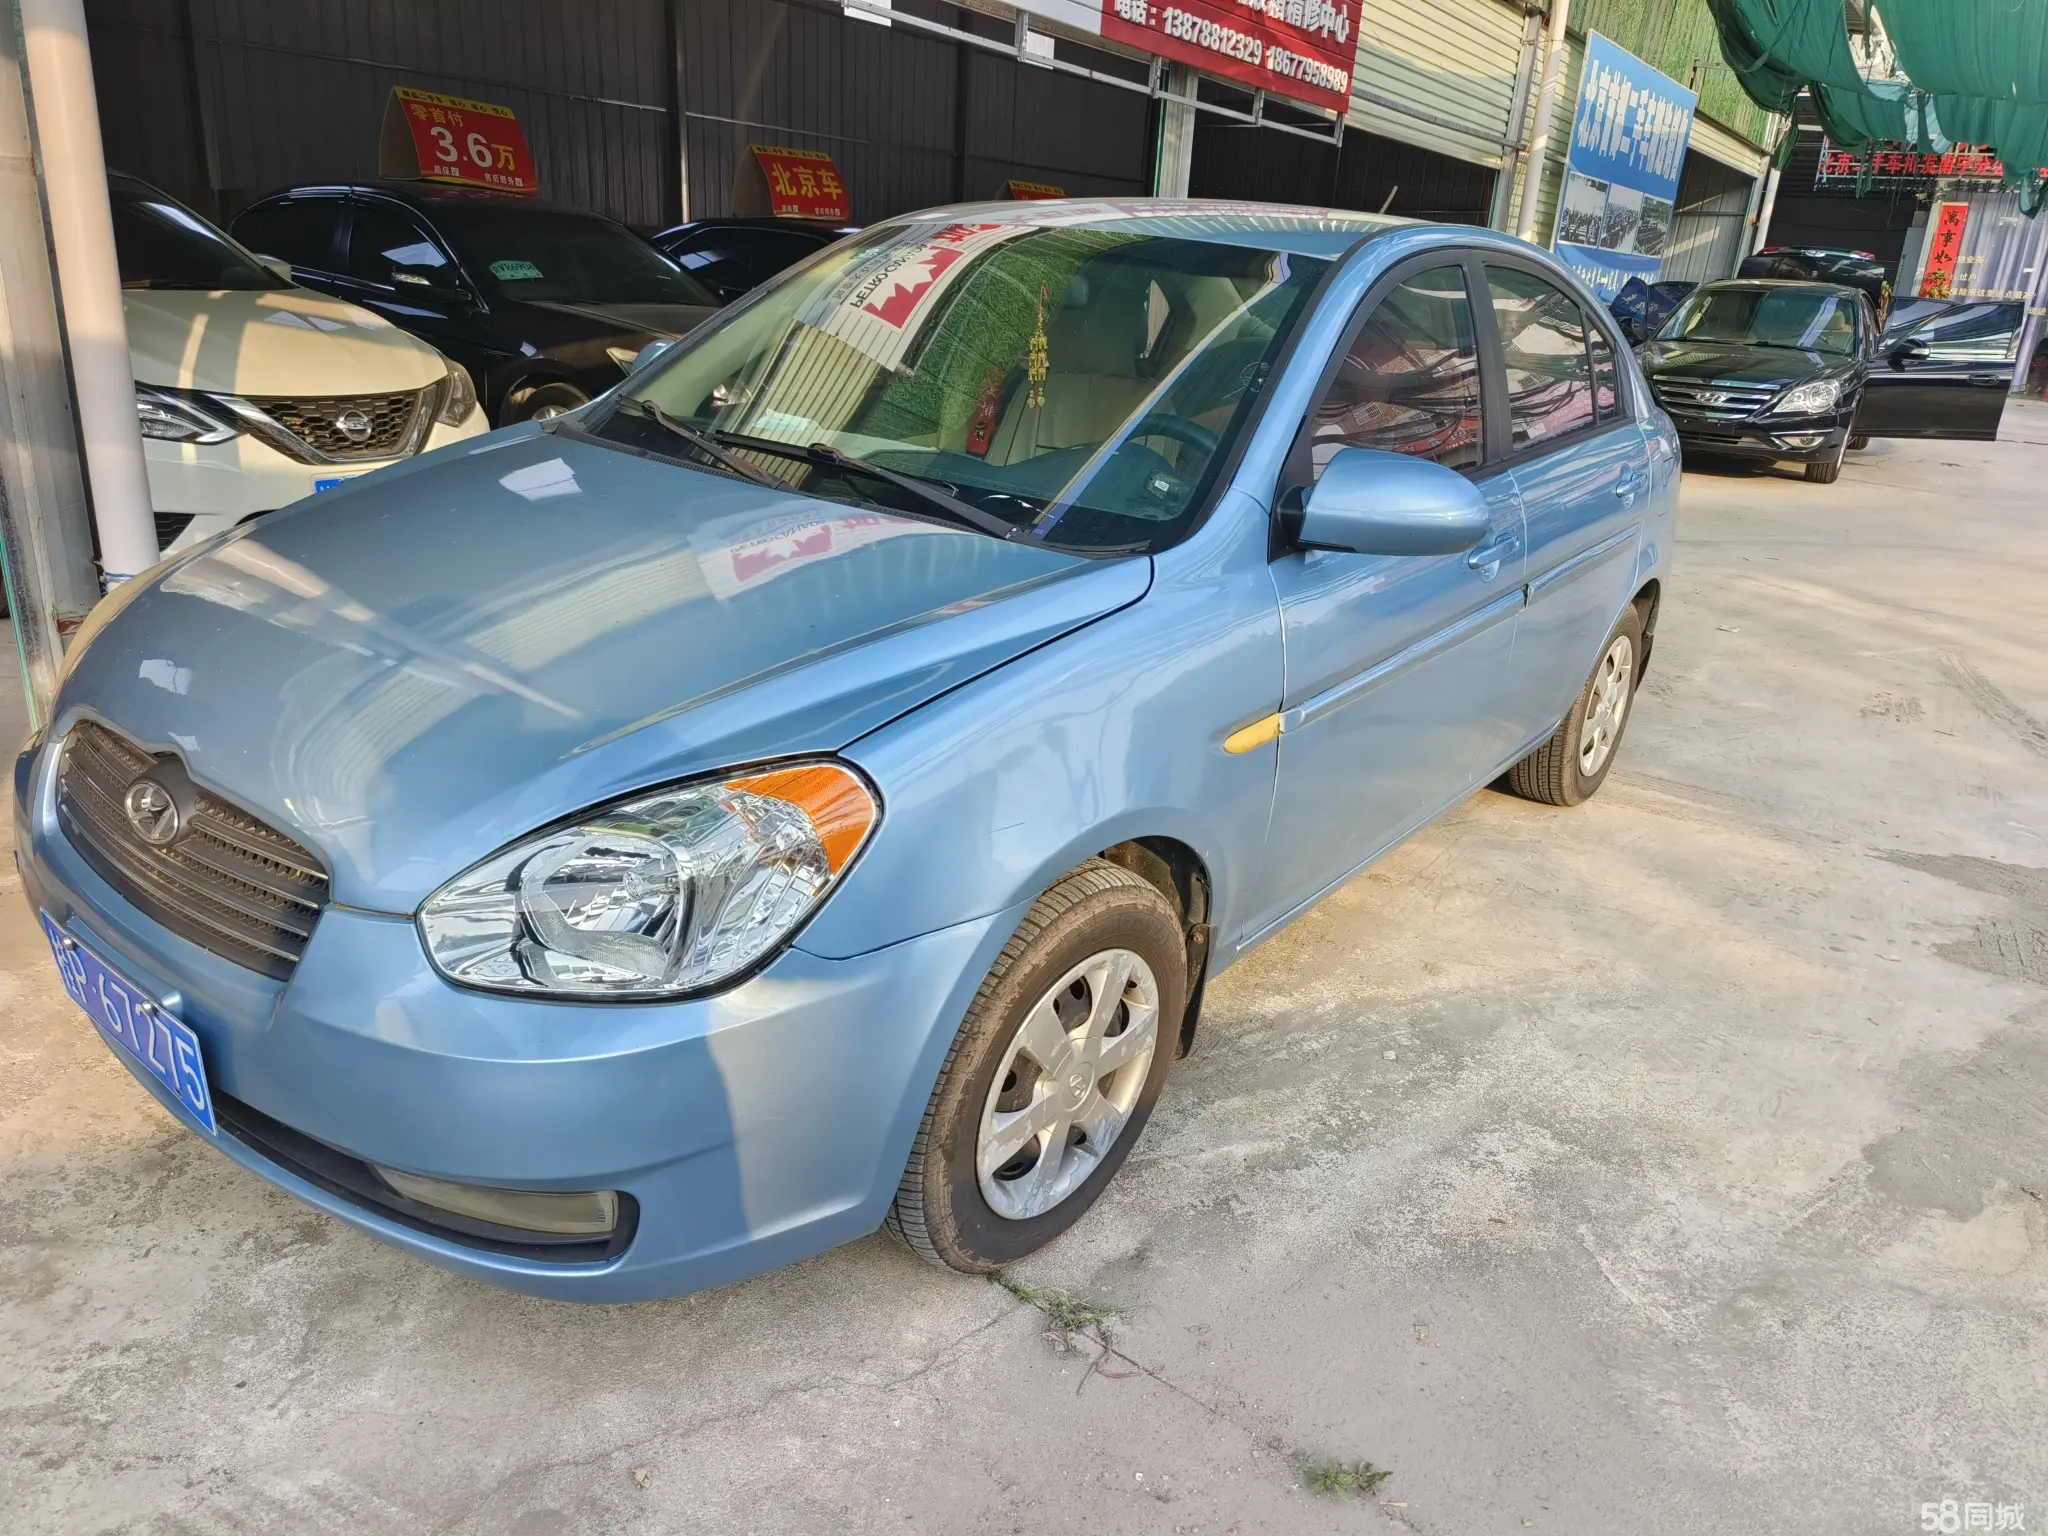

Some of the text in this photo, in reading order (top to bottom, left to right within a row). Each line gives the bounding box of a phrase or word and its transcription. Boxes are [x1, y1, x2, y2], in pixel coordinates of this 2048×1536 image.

[1236, 0, 1349, 43] 箱精修中心
[1162, 6, 1263, 65] 13878812329
[1265, 45, 1349, 94] 18677958989
[410, 103, 464, 128] 零首付
[771, 163, 843, 201] 北京车
